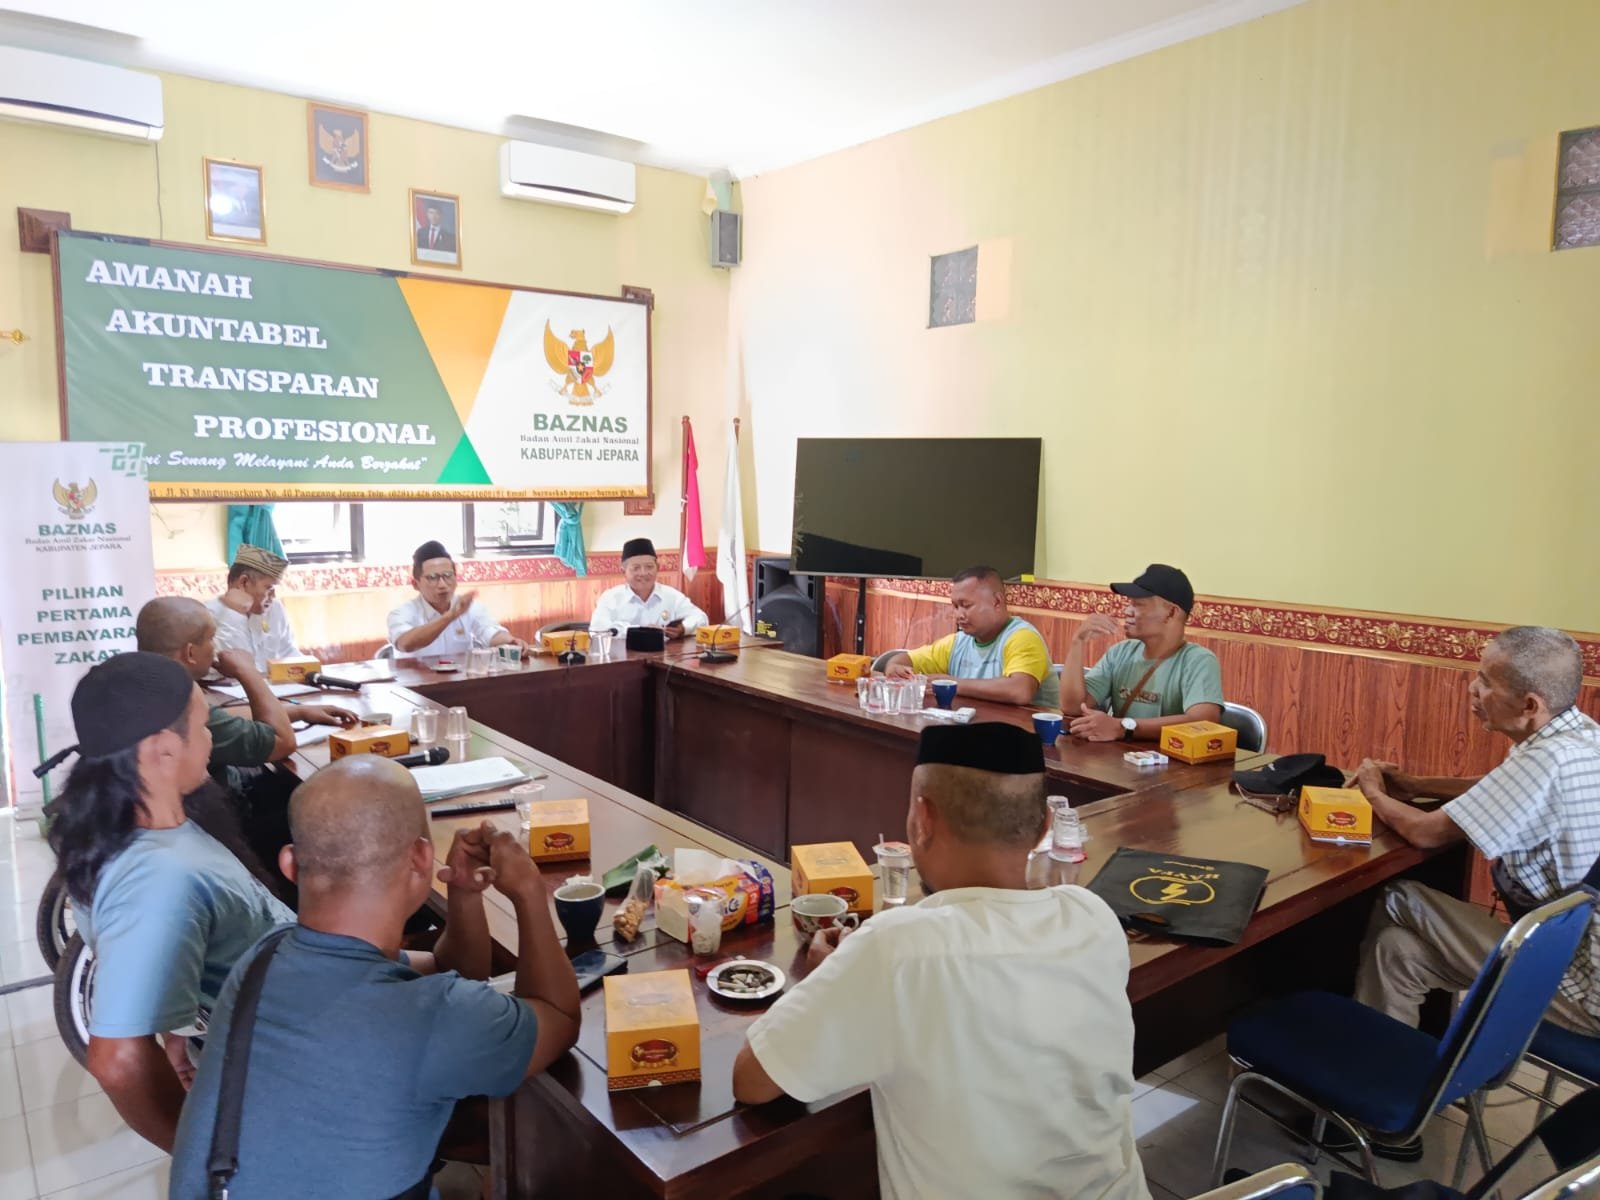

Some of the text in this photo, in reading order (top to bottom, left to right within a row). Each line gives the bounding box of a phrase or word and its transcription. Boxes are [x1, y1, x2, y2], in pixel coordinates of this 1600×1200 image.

[86, 259, 252, 299] AMANAH
[105, 309, 327, 349] AKUNTABEL
[142, 361, 379, 398] TRANSPARAN
[193, 415, 436, 445] PROFESIONAL
[533, 413, 628, 433] BAZNAS
[520, 434, 639, 445] Badan Amil Zakat Nasional
[167, 450, 227, 470] Senang
[233, 452, 309, 471] Melayani
[313, 454, 354, 469] Anda
[520, 447, 639, 462] KABUPATEN JEPARA
[38, 522, 117, 536] BAZNAS
[35, 543, 122, 553] KABUPATEN JEPARA
[42, 585, 124, 601] PILIHAN
[36, 606, 132, 622] PERTAMA
[17, 626, 138, 645] PEMBAYARA
